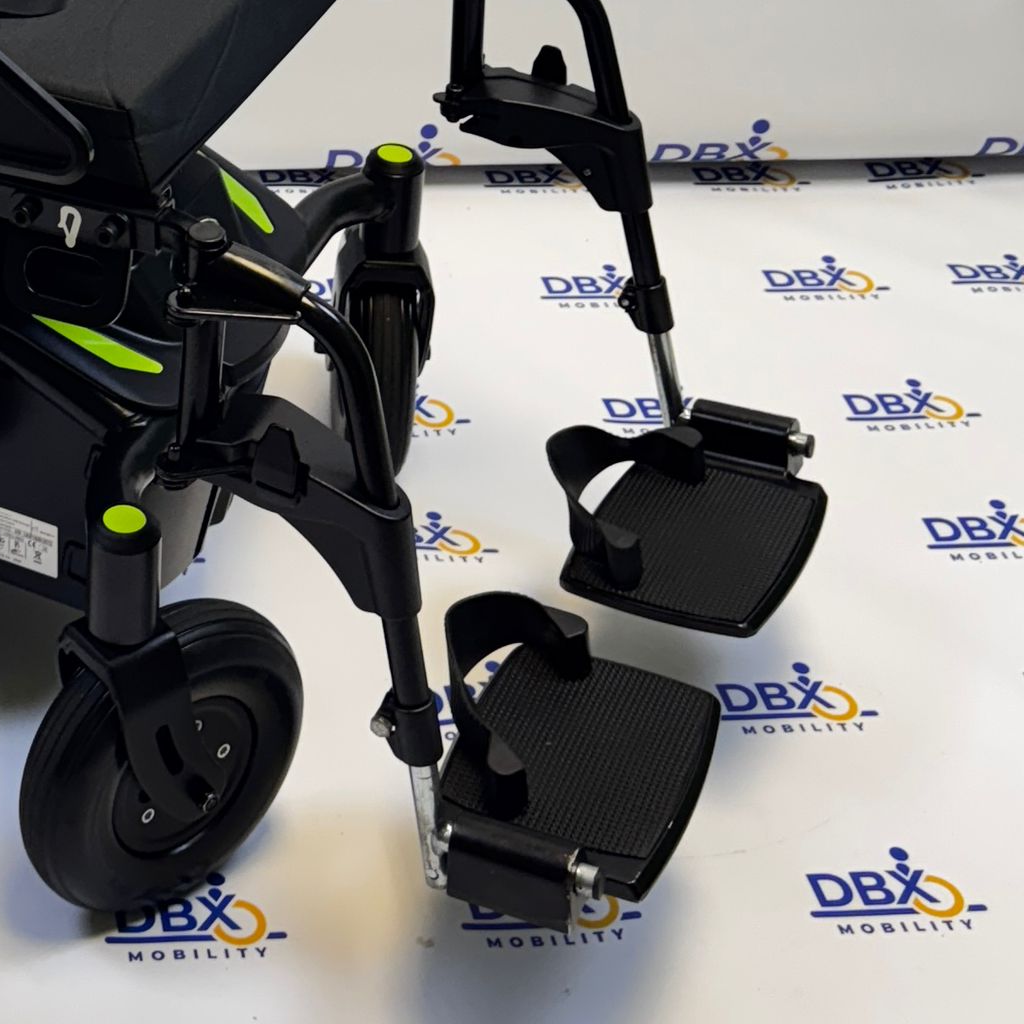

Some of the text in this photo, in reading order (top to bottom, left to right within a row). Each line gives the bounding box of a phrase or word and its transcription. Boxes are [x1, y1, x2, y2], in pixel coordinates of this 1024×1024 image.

[651, 142, 773, 161] DBX
[691, 166, 779, 182] DBX
[864, 160, 953, 176] DBX
[484, 169, 569, 184] DBX
[541, 276, 626, 294] DBX
[761, 267, 857, 287] DBX
[842, 392, 946, 415] DBX
[866, 420, 970, 432] MOBILITY
[922, 514, 1024, 542] DBX
[424, 554, 483, 563] ILITY
[949, 551, 1024, 562] MOBIL
[715, 681, 836, 712] DBX
[742, 722, 865, 735] MOBILITY
[806, 869, 941, 907] DBX
[837, 919, 972, 935] MOBILITY
[486, 928, 623, 948] MOBILITY
[128, 947, 266, 962] MOBILITY
